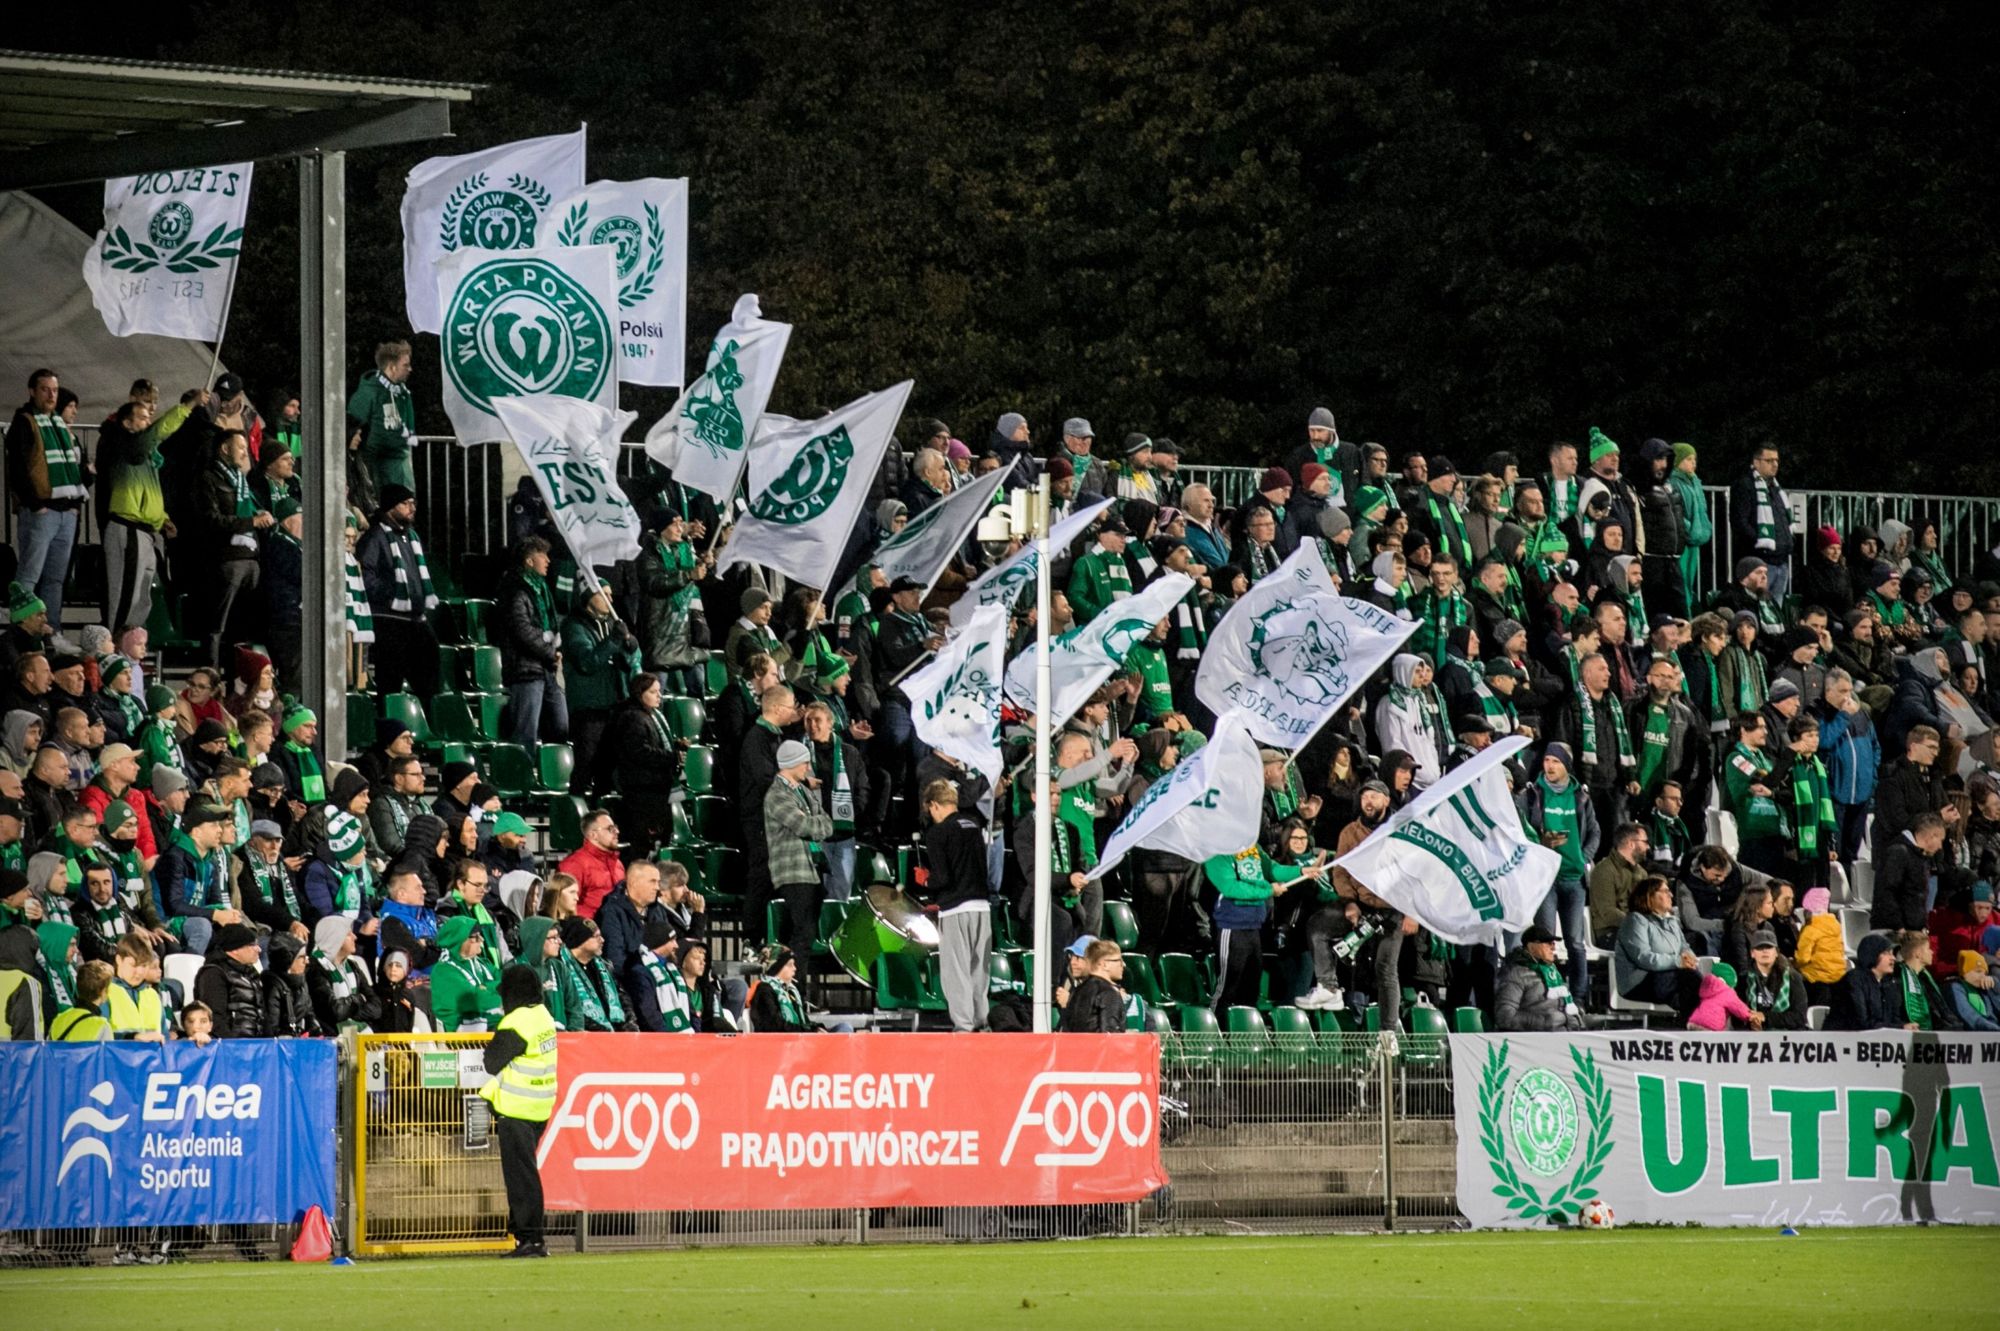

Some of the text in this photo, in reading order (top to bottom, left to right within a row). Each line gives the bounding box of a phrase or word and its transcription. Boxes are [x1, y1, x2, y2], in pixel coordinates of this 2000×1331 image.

[456, 267, 599, 373] WARTA POZNAŃ
[620, 320, 663, 339] Polski
[622, 343, 648, 358] 1947
[1610, 1040, 1674, 1062] NASZE
[1679, 1041, 1740, 1063] CZYNY
[1747, 1043, 1774, 1064] ZA
[1779, 1036, 1837, 1063] ŻYCIA
[1857, 1043, 1907, 1069] BĘDĄ
[1913, 1043, 1973, 1064] ECHEM
[372, 1062, 381, 1080] 8
[463, 1065, 484, 1073] STREFA
[142, 1072, 262, 1121] Enea
[766, 1073, 935, 1110] AGREGATY
[140, 1131, 243, 1158] Akademia
[721, 1122, 980, 1178] PRĄDOTWÓRCZE
[140, 1163, 211, 1195] Sportu
